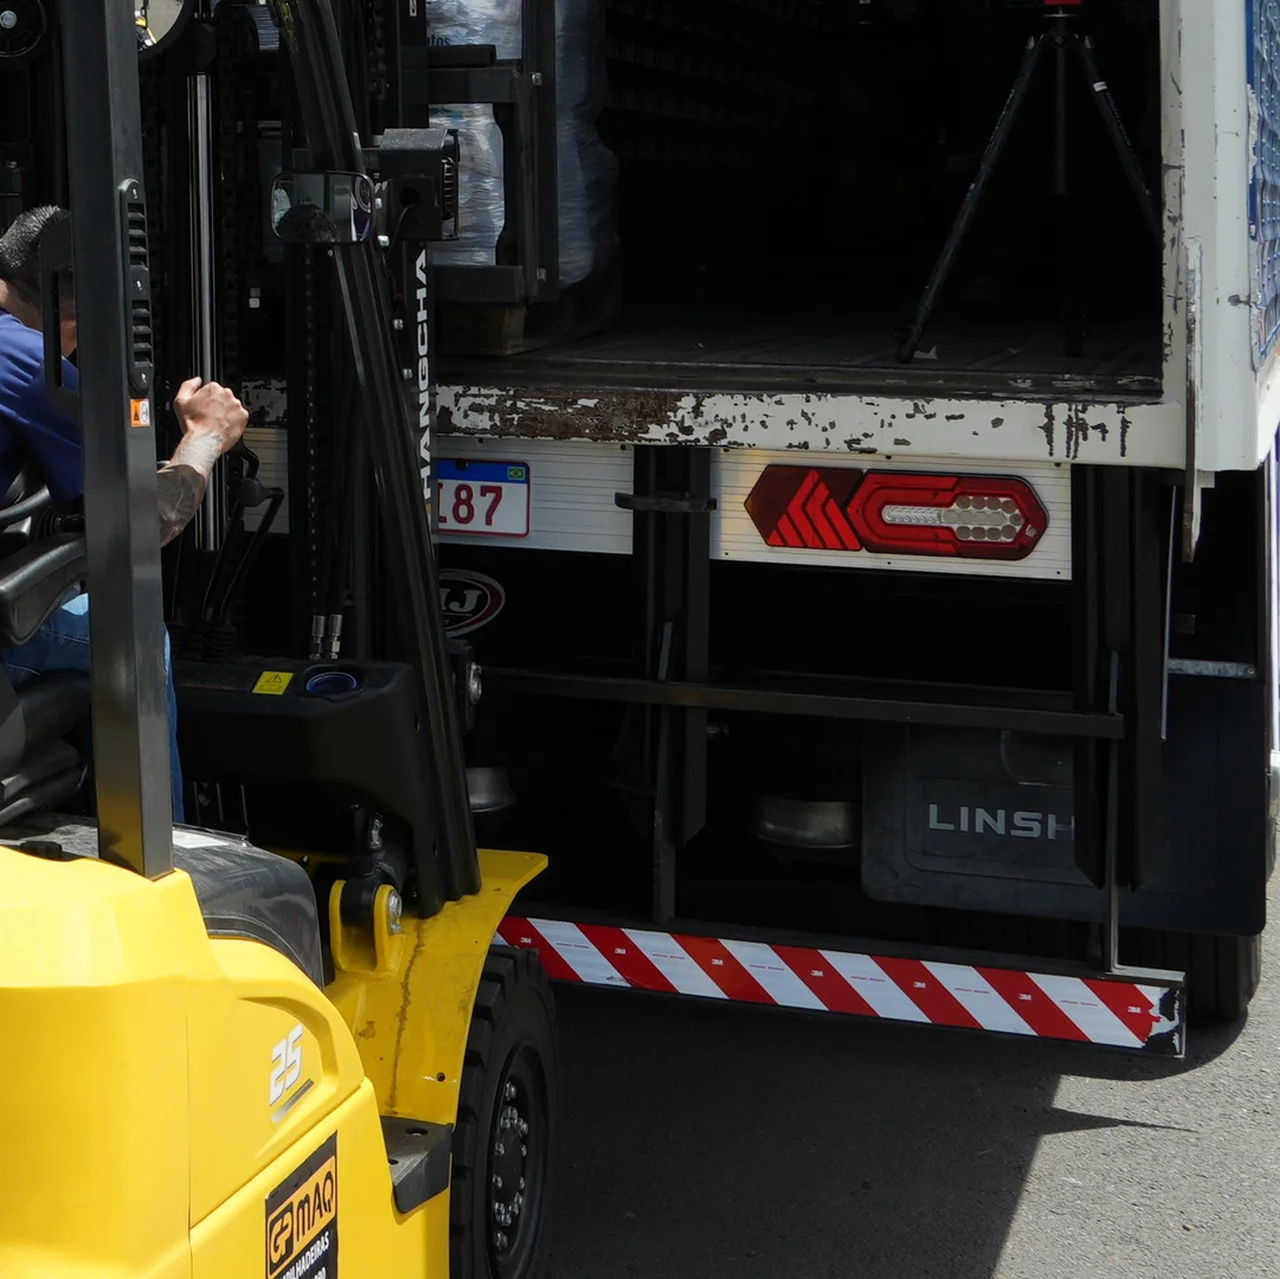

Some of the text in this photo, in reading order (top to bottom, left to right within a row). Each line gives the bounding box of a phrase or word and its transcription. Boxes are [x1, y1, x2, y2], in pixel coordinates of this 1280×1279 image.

[415, 248, 432, 500] HANGCHA
[520, 936, 532, 944] 3M
[614, 947, 626, 955] 3M
[711, 958, 724, 966] 3M
[811, 969, 824, 978] 3M
[913, 980, 926, 989] 3M
[1018, 993, 1032, 1001] 3M
[1127, 1005, 1141, 1014] 3M
[269, 1023, 305, 1107] 25
